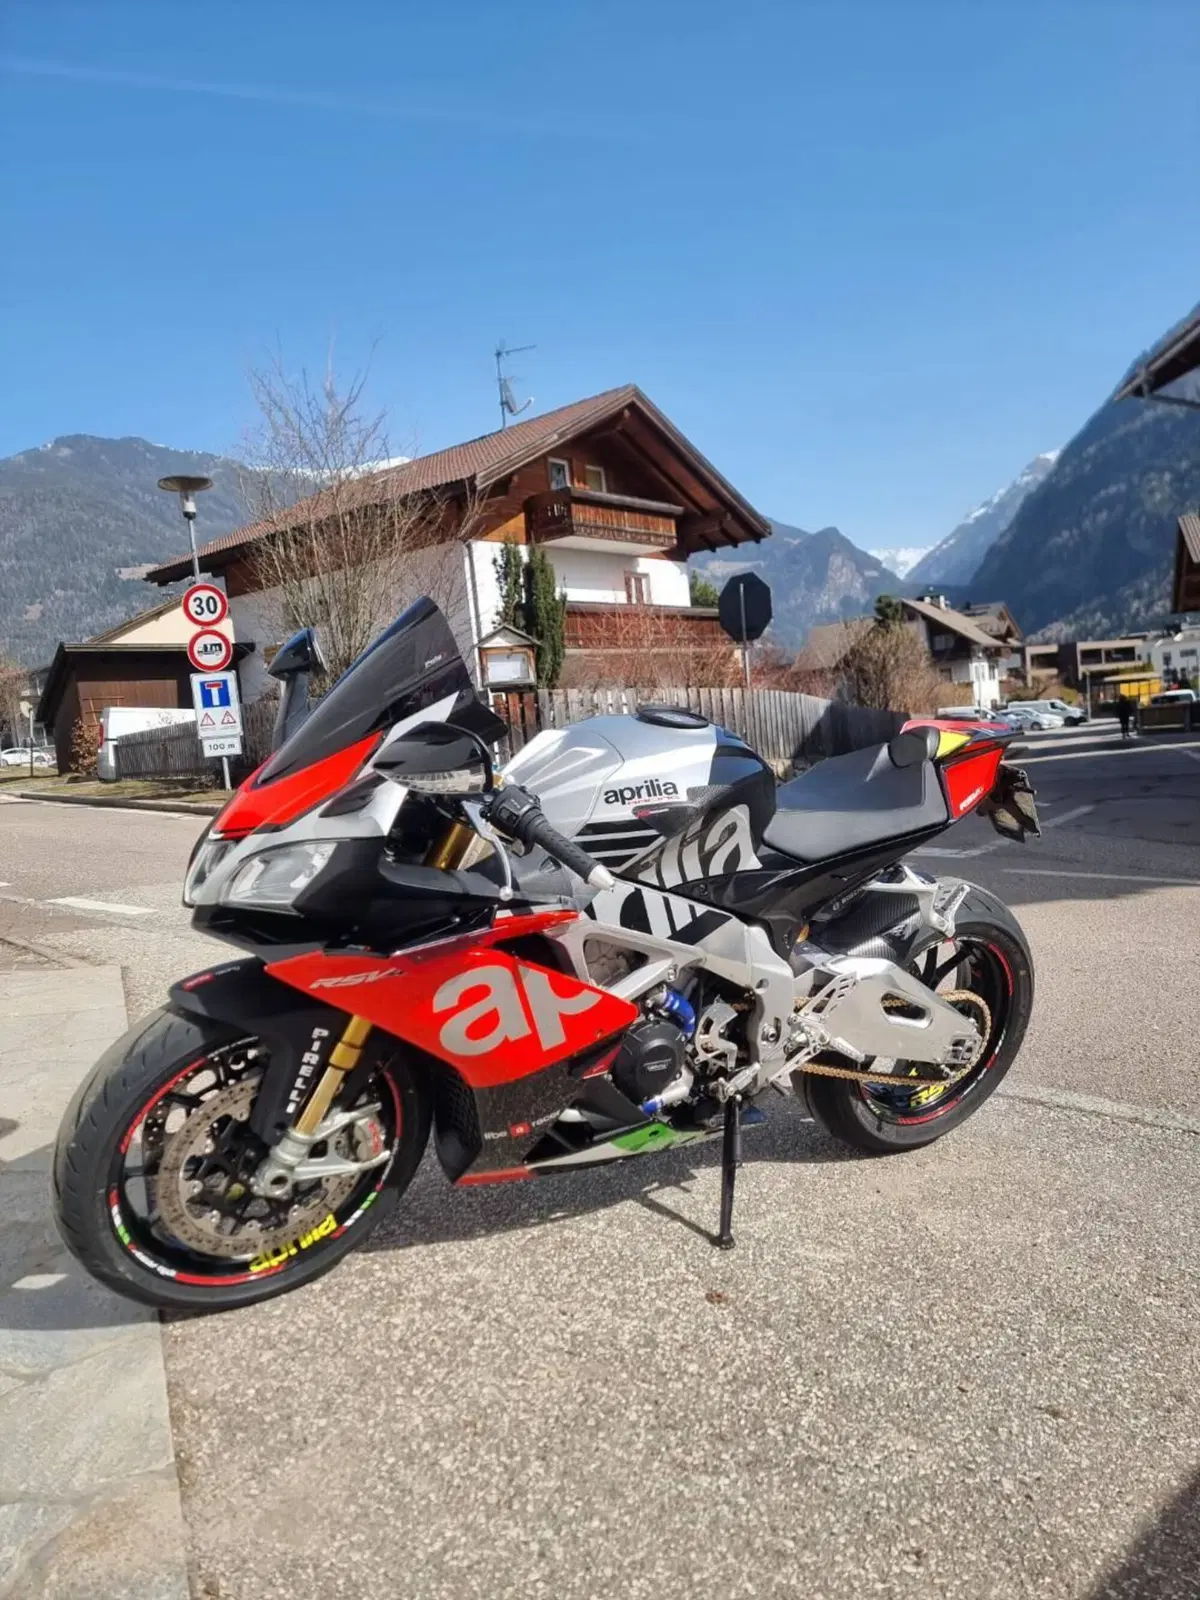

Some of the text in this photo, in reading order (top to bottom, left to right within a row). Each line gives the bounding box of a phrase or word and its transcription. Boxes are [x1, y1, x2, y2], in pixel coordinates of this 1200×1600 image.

[193, 596, 218, 616] 30
[208, 743, 225, 751] 100
[603, 778, 679, 805] aprilia
[285, 1027, 330, 1114] PIRELLI
